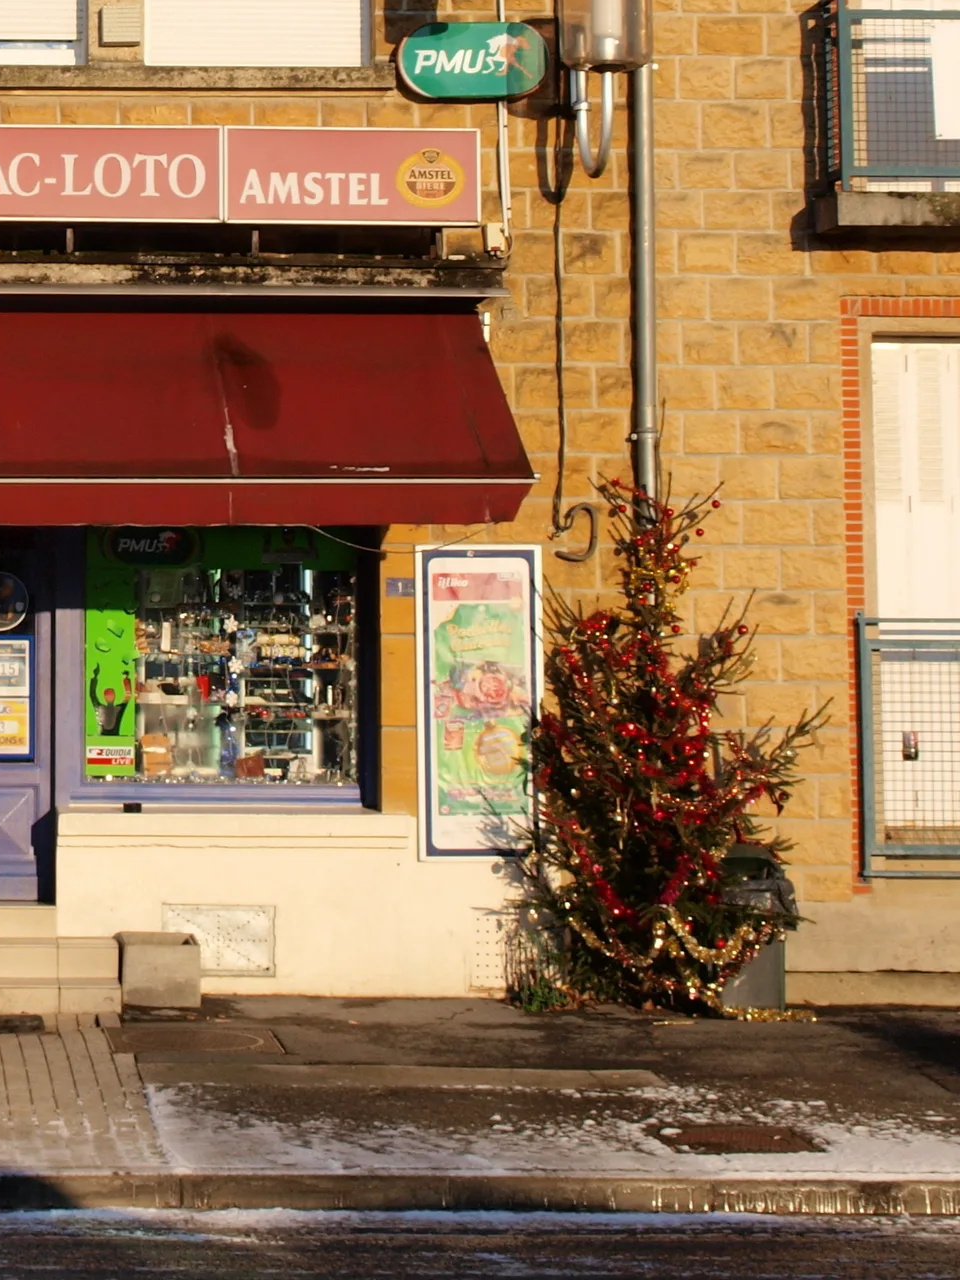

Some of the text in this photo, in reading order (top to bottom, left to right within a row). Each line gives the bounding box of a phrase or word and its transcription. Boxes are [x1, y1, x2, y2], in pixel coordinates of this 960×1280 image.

[414, 49, 486, 75] PMU
[408, 169, 454, 180] AMSTEL
[239, 168, 390, 206] AMSTEL
[117, 537, 158, 553] PMU
[0, 663, 16, 675] 15
